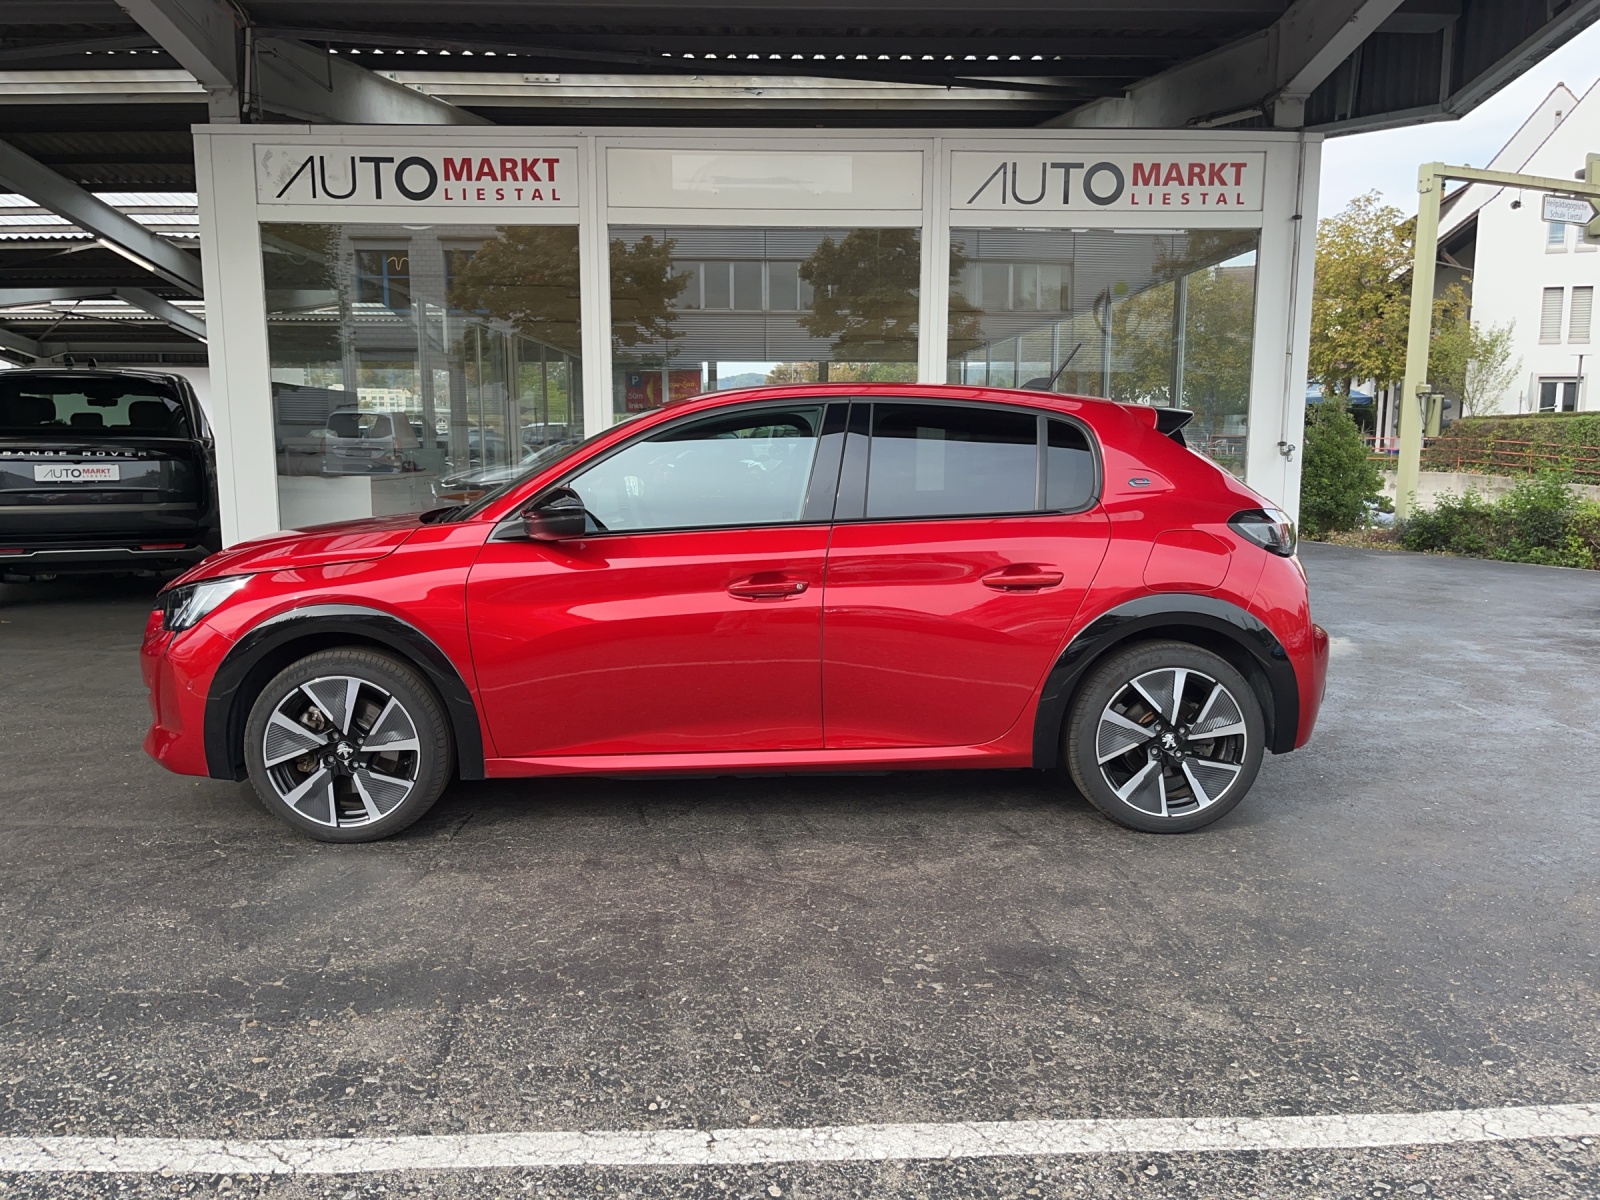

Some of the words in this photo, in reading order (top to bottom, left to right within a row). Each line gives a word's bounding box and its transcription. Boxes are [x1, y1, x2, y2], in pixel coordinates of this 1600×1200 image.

[275, 155, 438, 201] AUTO
[442, 157, 560, 182] MARKT
[966, 161, 1125, 206] AUTO
[1131, 162, 1247, 187] MARKT
[444, 188, 561, 201] LIESTAL
[1130, 192, 1245, 205] LIESTAL
[1546, 199, 1588, 211] Heilpädagogische
[1550, 210, 1566, 219] Schule
[1567, 211, 1583, 221] Liestal
[631, 375, 639, 385] P
[43, 468, 82, 478] AUTO
